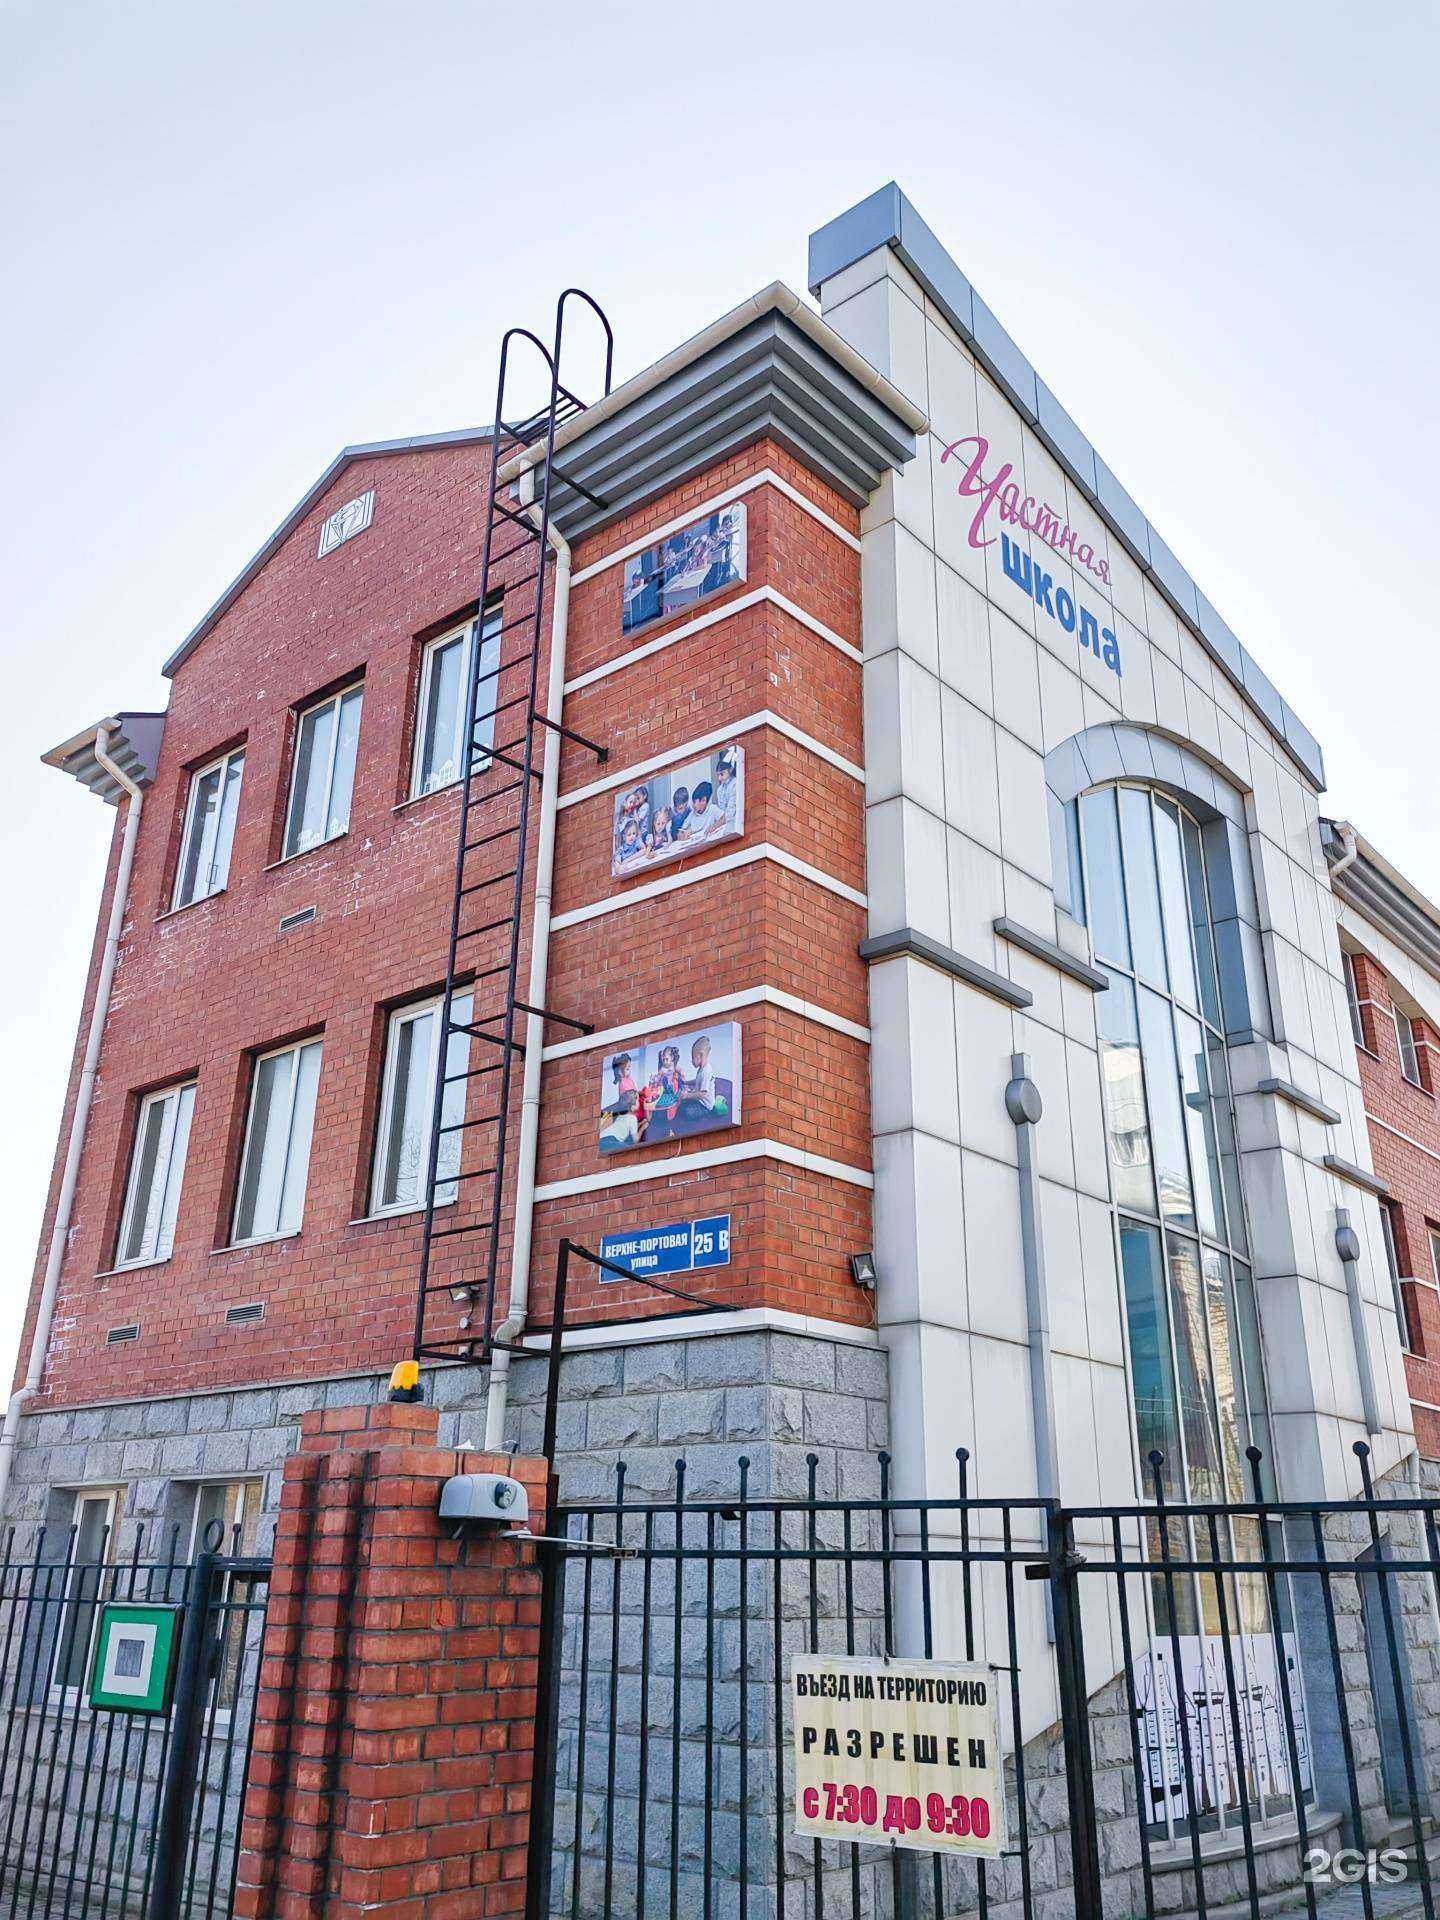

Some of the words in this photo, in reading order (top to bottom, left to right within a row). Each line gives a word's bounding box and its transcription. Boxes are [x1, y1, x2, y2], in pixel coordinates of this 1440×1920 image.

[941, 436, 1113, 586] Частная
[605, 1232, 688, 1258] ВЕРХНЕ-ПОРТОВАЯ
[694, 1232, 713, 1255] 25
[719, 1229, 729, 1251] В
[630, 1254, 658, 1271] улица
[796, 1673, 851, 1702] ВЪЕЗД
[854, 1674, 875, 1700] НА
[877, 1676, 987, 1706] ТЕРРИТОРИЮ
[802, 1727, 986, 1769] РАЗРЕШЕН
[823, 1782, 878, 1826] 7:30
[926, 1792, 991, 1839] 9:30
